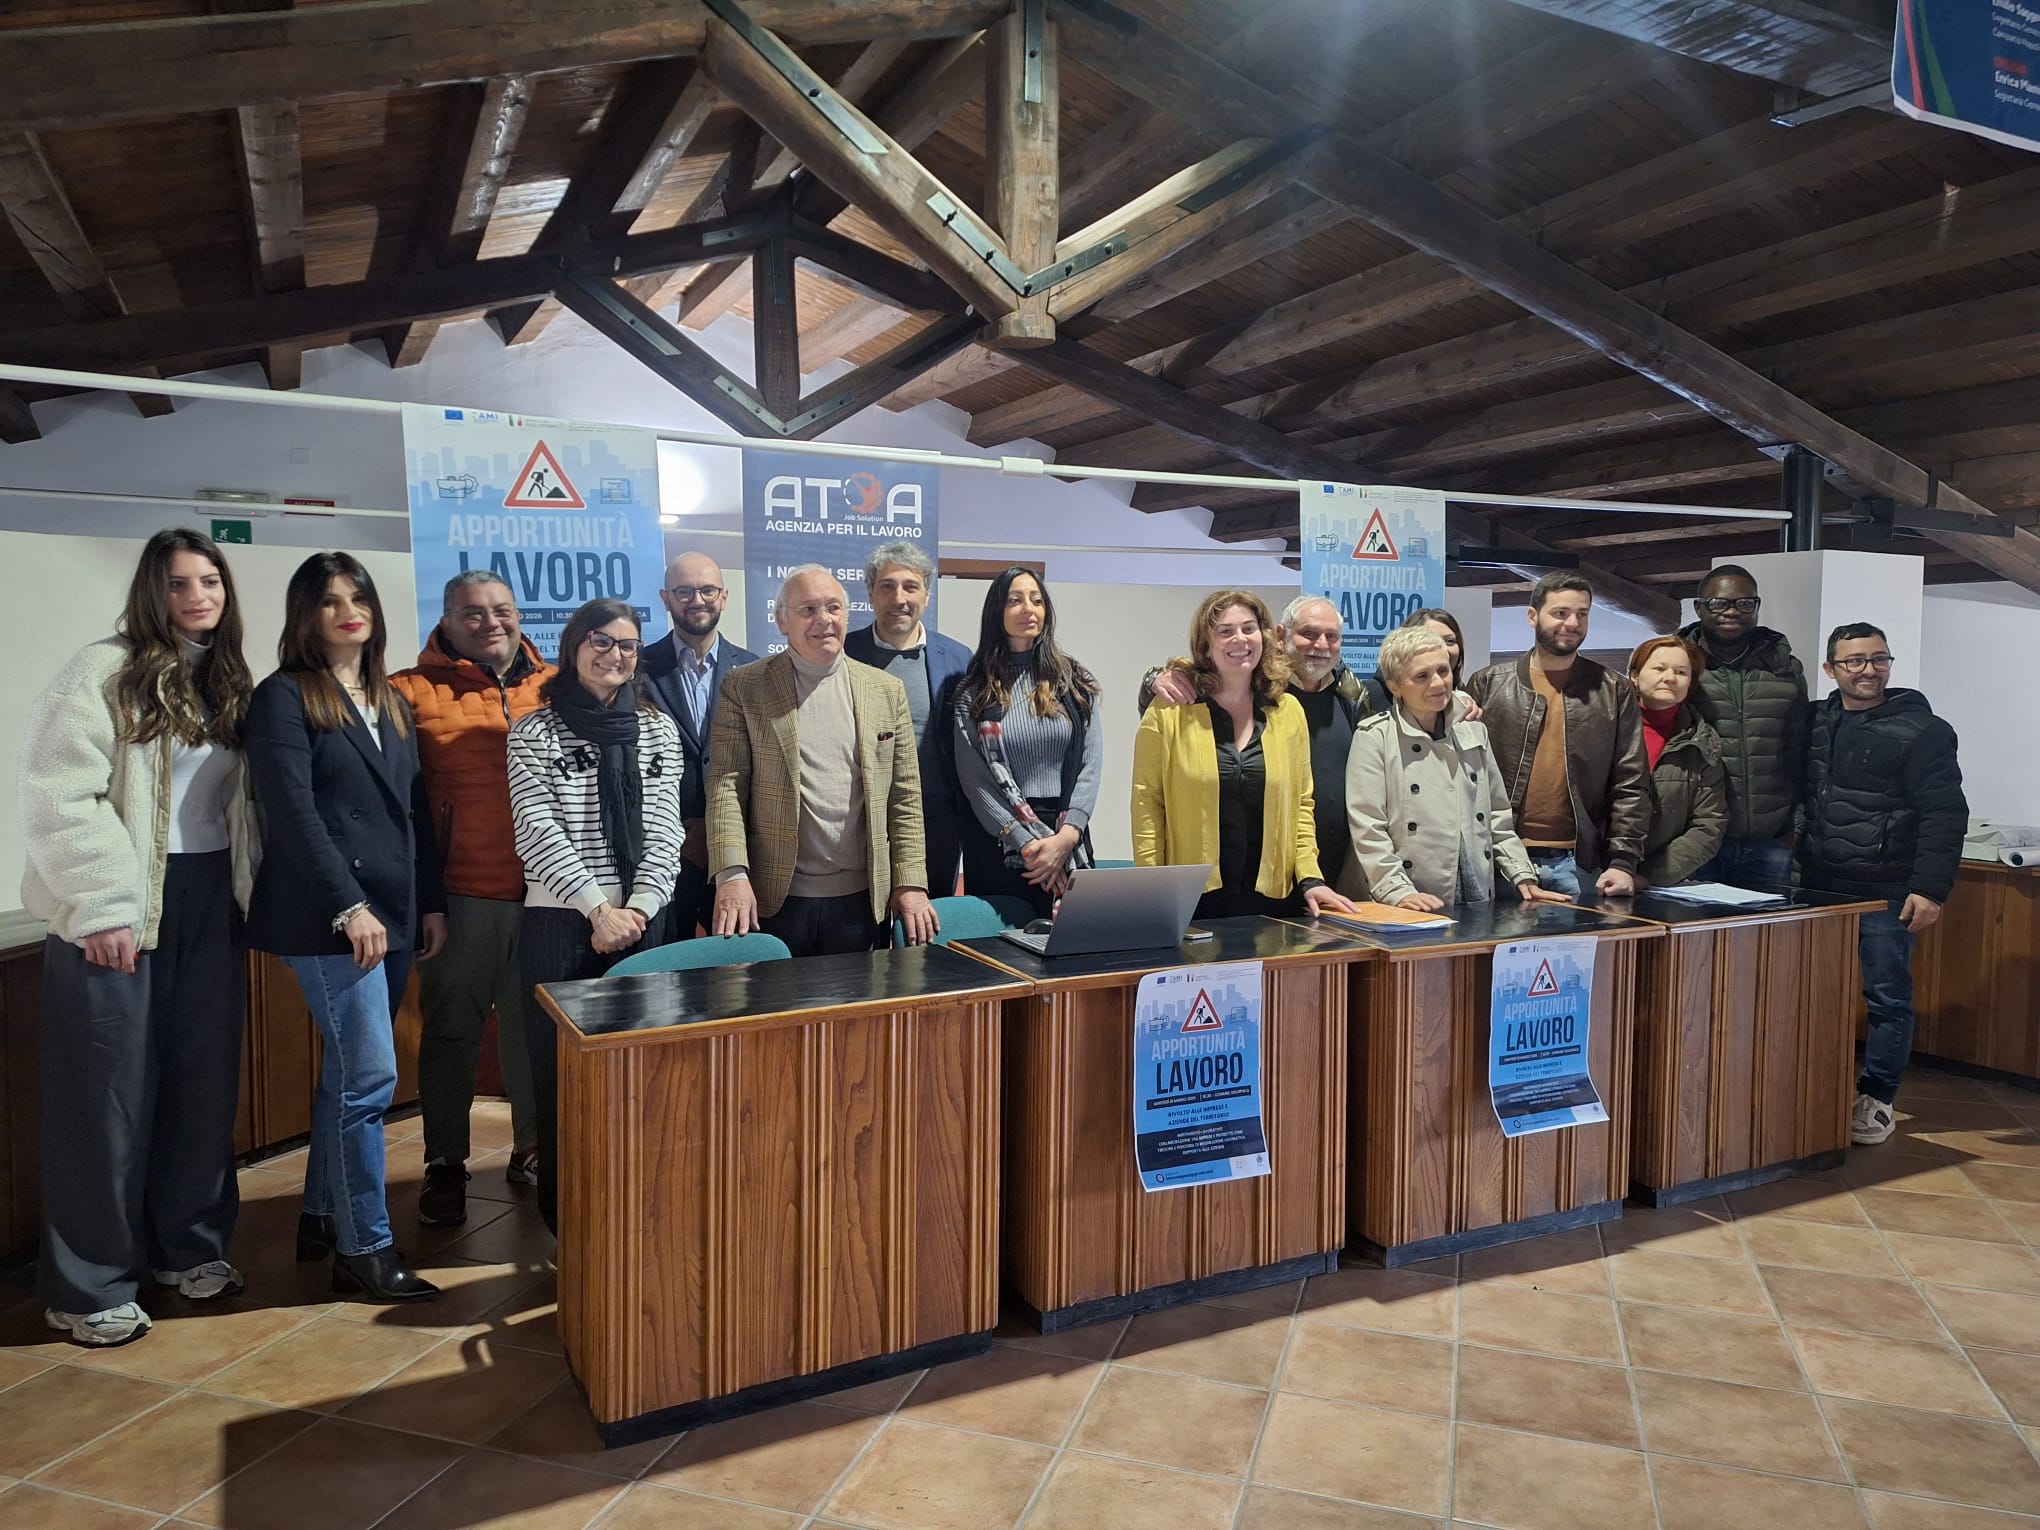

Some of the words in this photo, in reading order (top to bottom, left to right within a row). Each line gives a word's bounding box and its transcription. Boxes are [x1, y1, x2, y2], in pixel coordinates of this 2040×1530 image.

[448, 511, 635, 548] APPORTUNITÀ
[765, 520, 824, 534] AGENZIA
[827, 523, 853, 535] PER
[857, 524, 868, 536] IL
[871, 525, 922, 538] LAVORO
[857, 514, 884, 522] Solution
[1319, 562, 1427, 591] APPORTUNITÀ
[1324, 590, 1423, 631] AVORO
[1503, 992, 1578, 1022] APPORTUNITÀ
[1152, 1026, 1246, 1061] APPORTUNITÀ
[1506, 1015, 1575, 1052] LAVORO
[1156, 1052, 1243, 1095] LAVORO
